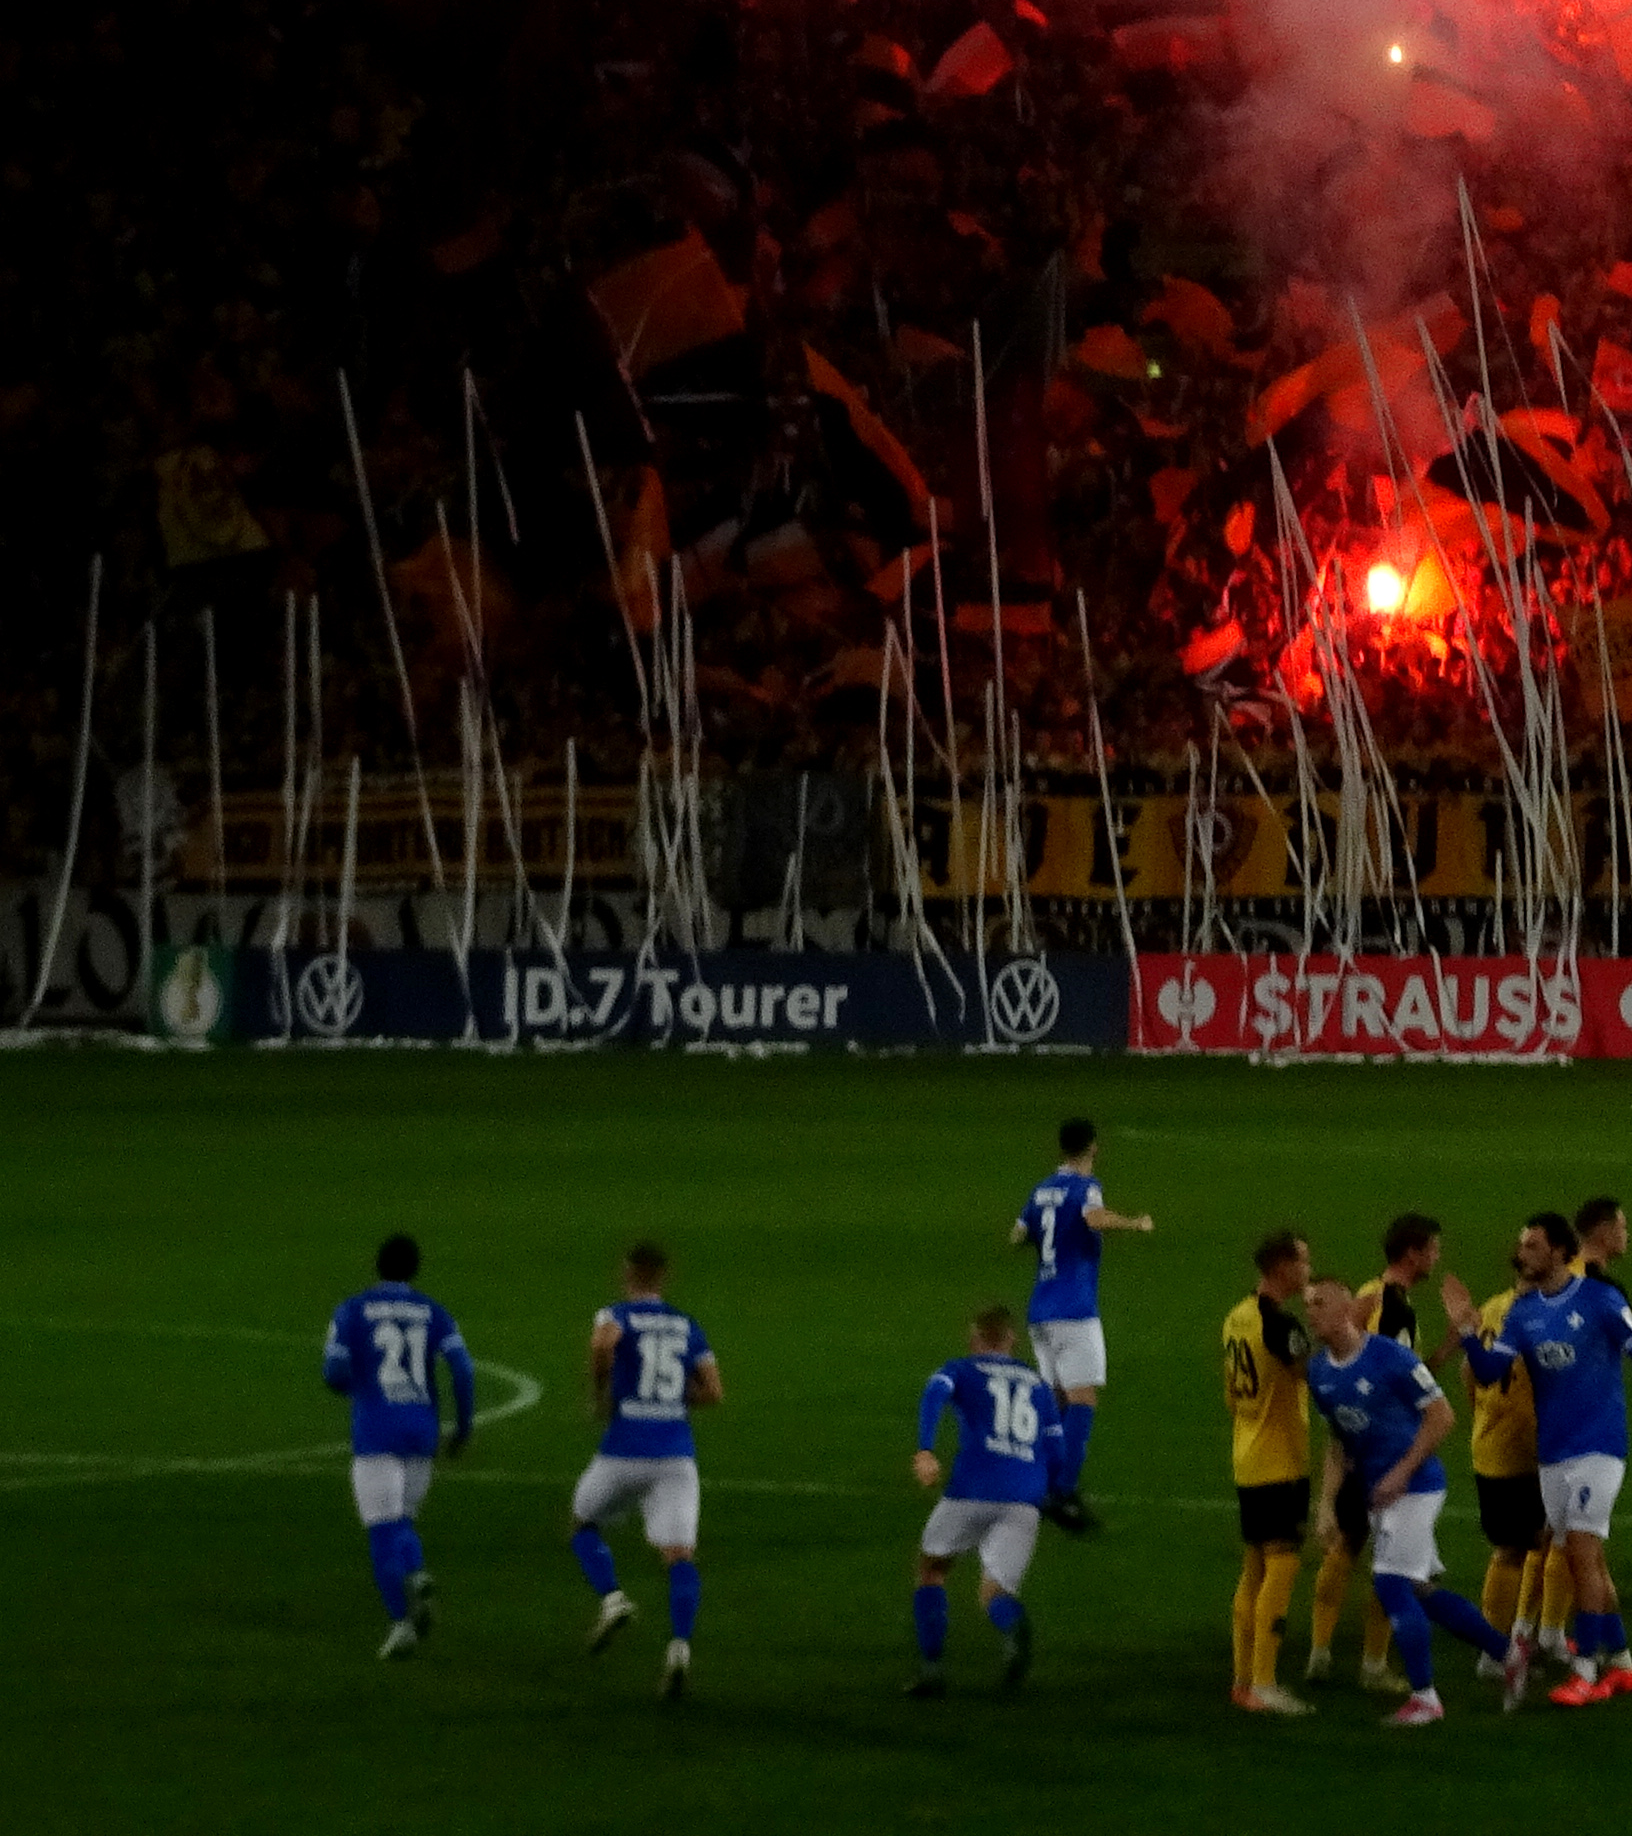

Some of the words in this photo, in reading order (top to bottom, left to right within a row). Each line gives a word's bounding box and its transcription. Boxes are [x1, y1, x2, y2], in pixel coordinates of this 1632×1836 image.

[504, 967, 627, 1030] ID.7
[641, 969, 850, 1031] Tourer
[991, 960, 1060, 1043] VW
[1250, 972, 1583, 1041] STRAUSS
[986, 1377, 1039, 1444] 16
